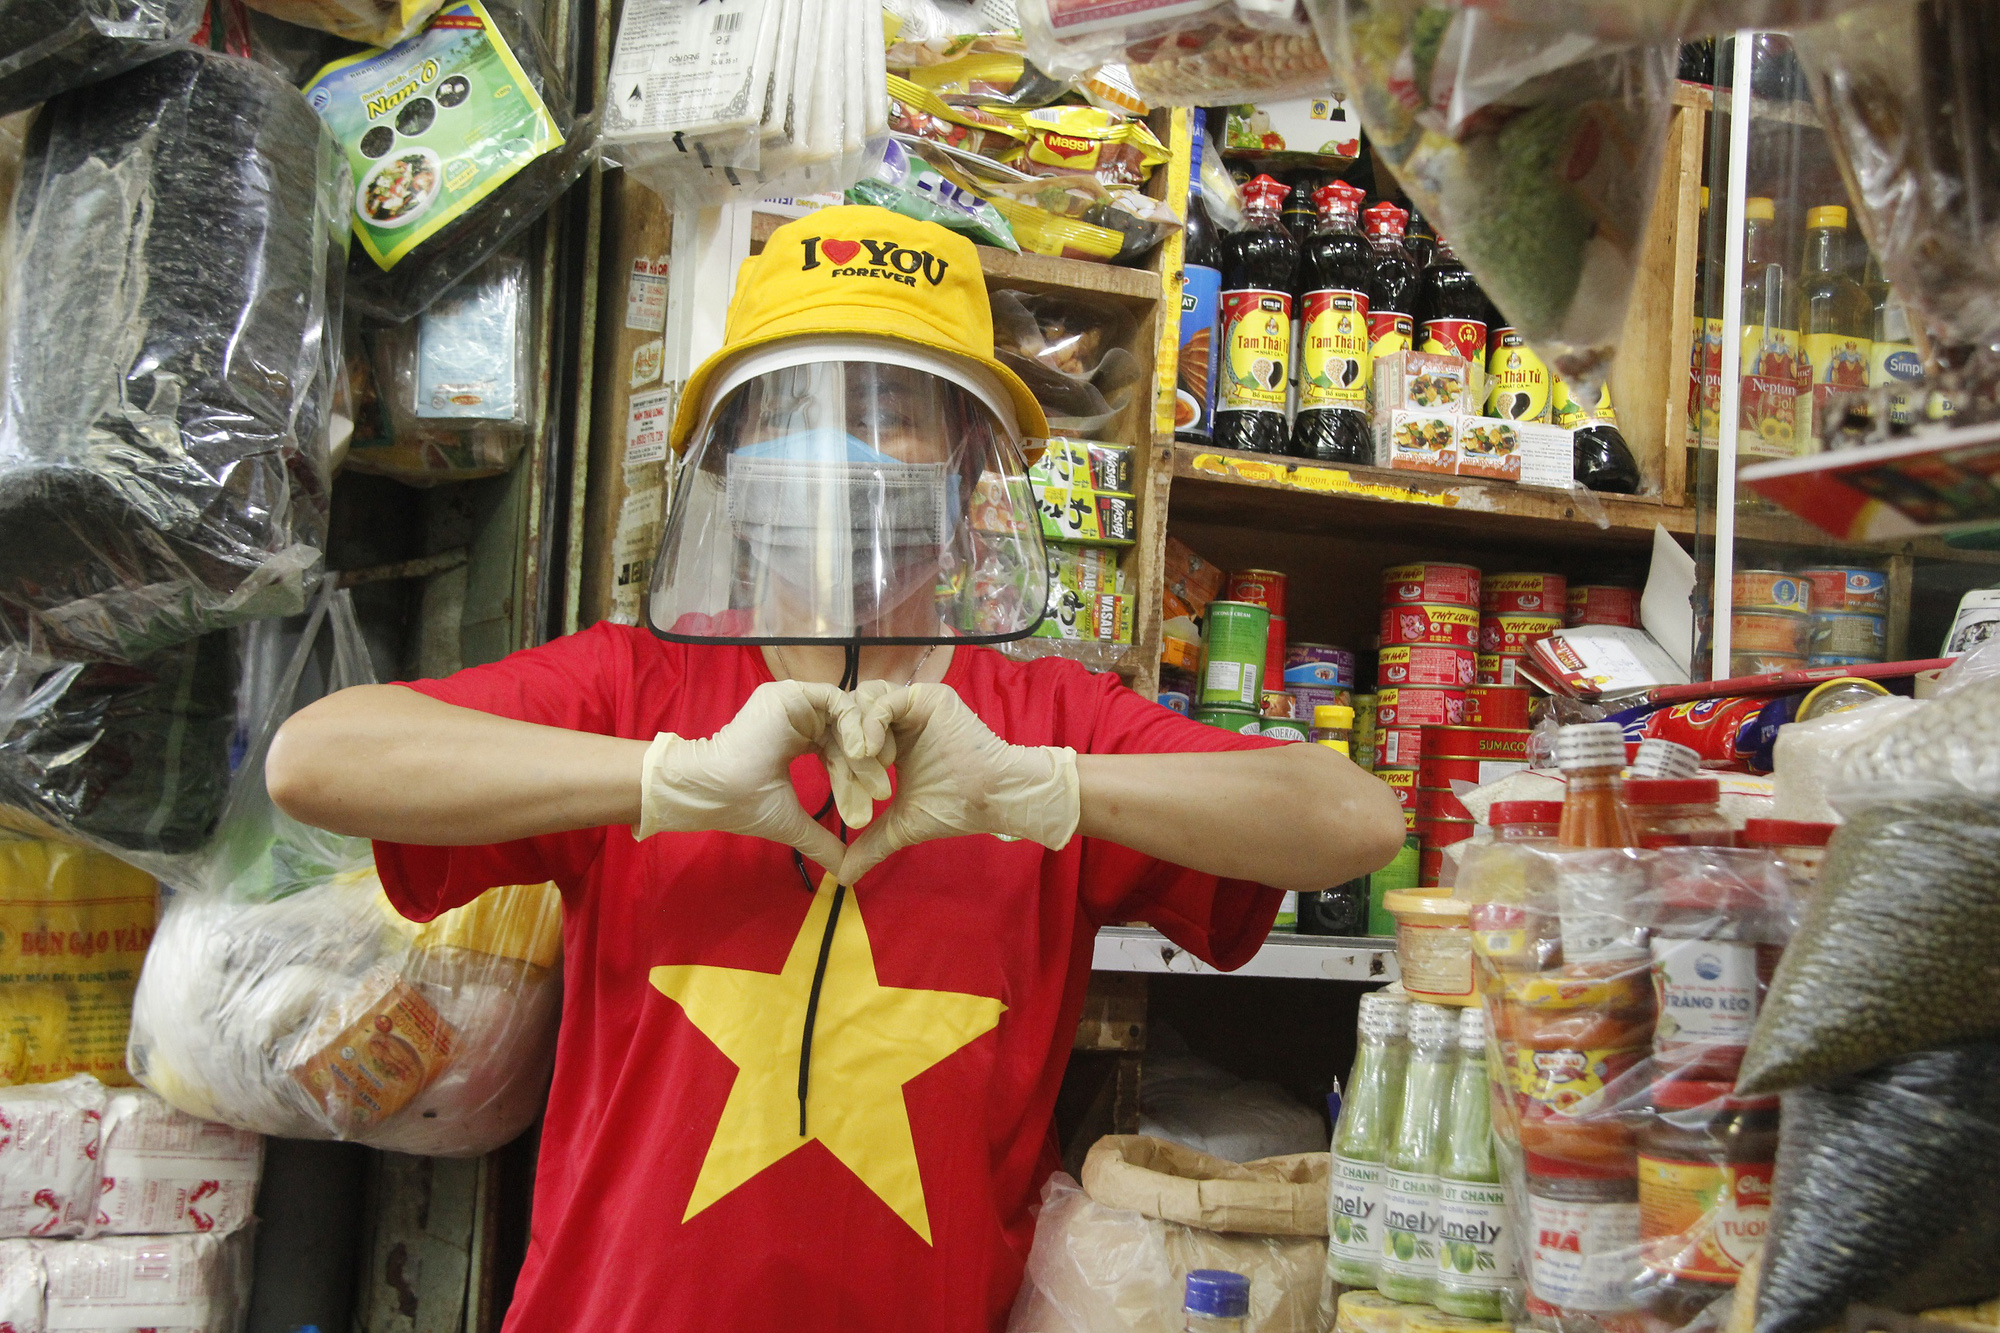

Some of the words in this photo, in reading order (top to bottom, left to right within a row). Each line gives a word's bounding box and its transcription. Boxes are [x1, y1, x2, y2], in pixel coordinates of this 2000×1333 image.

[367, 79, 421, 120] Nam
[420, 59, 440, 86] Ô
[1048, 136, 1091, 152] Maggi
[800, 236, 821, 272] I
[860, 239, 949, 287] YOU
[831, 266, 917, 288] FOREVER
[1237, 335, 1260, 349] Tam
[1262, 335, 1283, 350] Thái
[1311, 335, 1332, 350] Tam
[1334, 334, 1357, 350] Thái
[1504, 369, 1527, 384] Thái
[1528, 369, 1542, 384] Tử
[1689, 368, 1722, 387] Neptu
[1752, 377, 1797, 397] Neptun
[1104, 448, 1120, 491] WASABI
[1111, 498, 1126, 540] WASABI
[1100, 594, 1114, 641] WASABI
[1431, 611, 1453, 622] THỊT
[1505, 622, 1529, 632] THỊT
[1556, 637, 1586, 669] Neptune
[1479, 739, 1527, 752] SUMACO
[1388, 773, 1411, 784] PORK
[1343, 1166, 1379, 1181] CHANH
[1460, 1188, 1504, 1204] CHANH
[1333, 1194, 1376, 1219] mely
